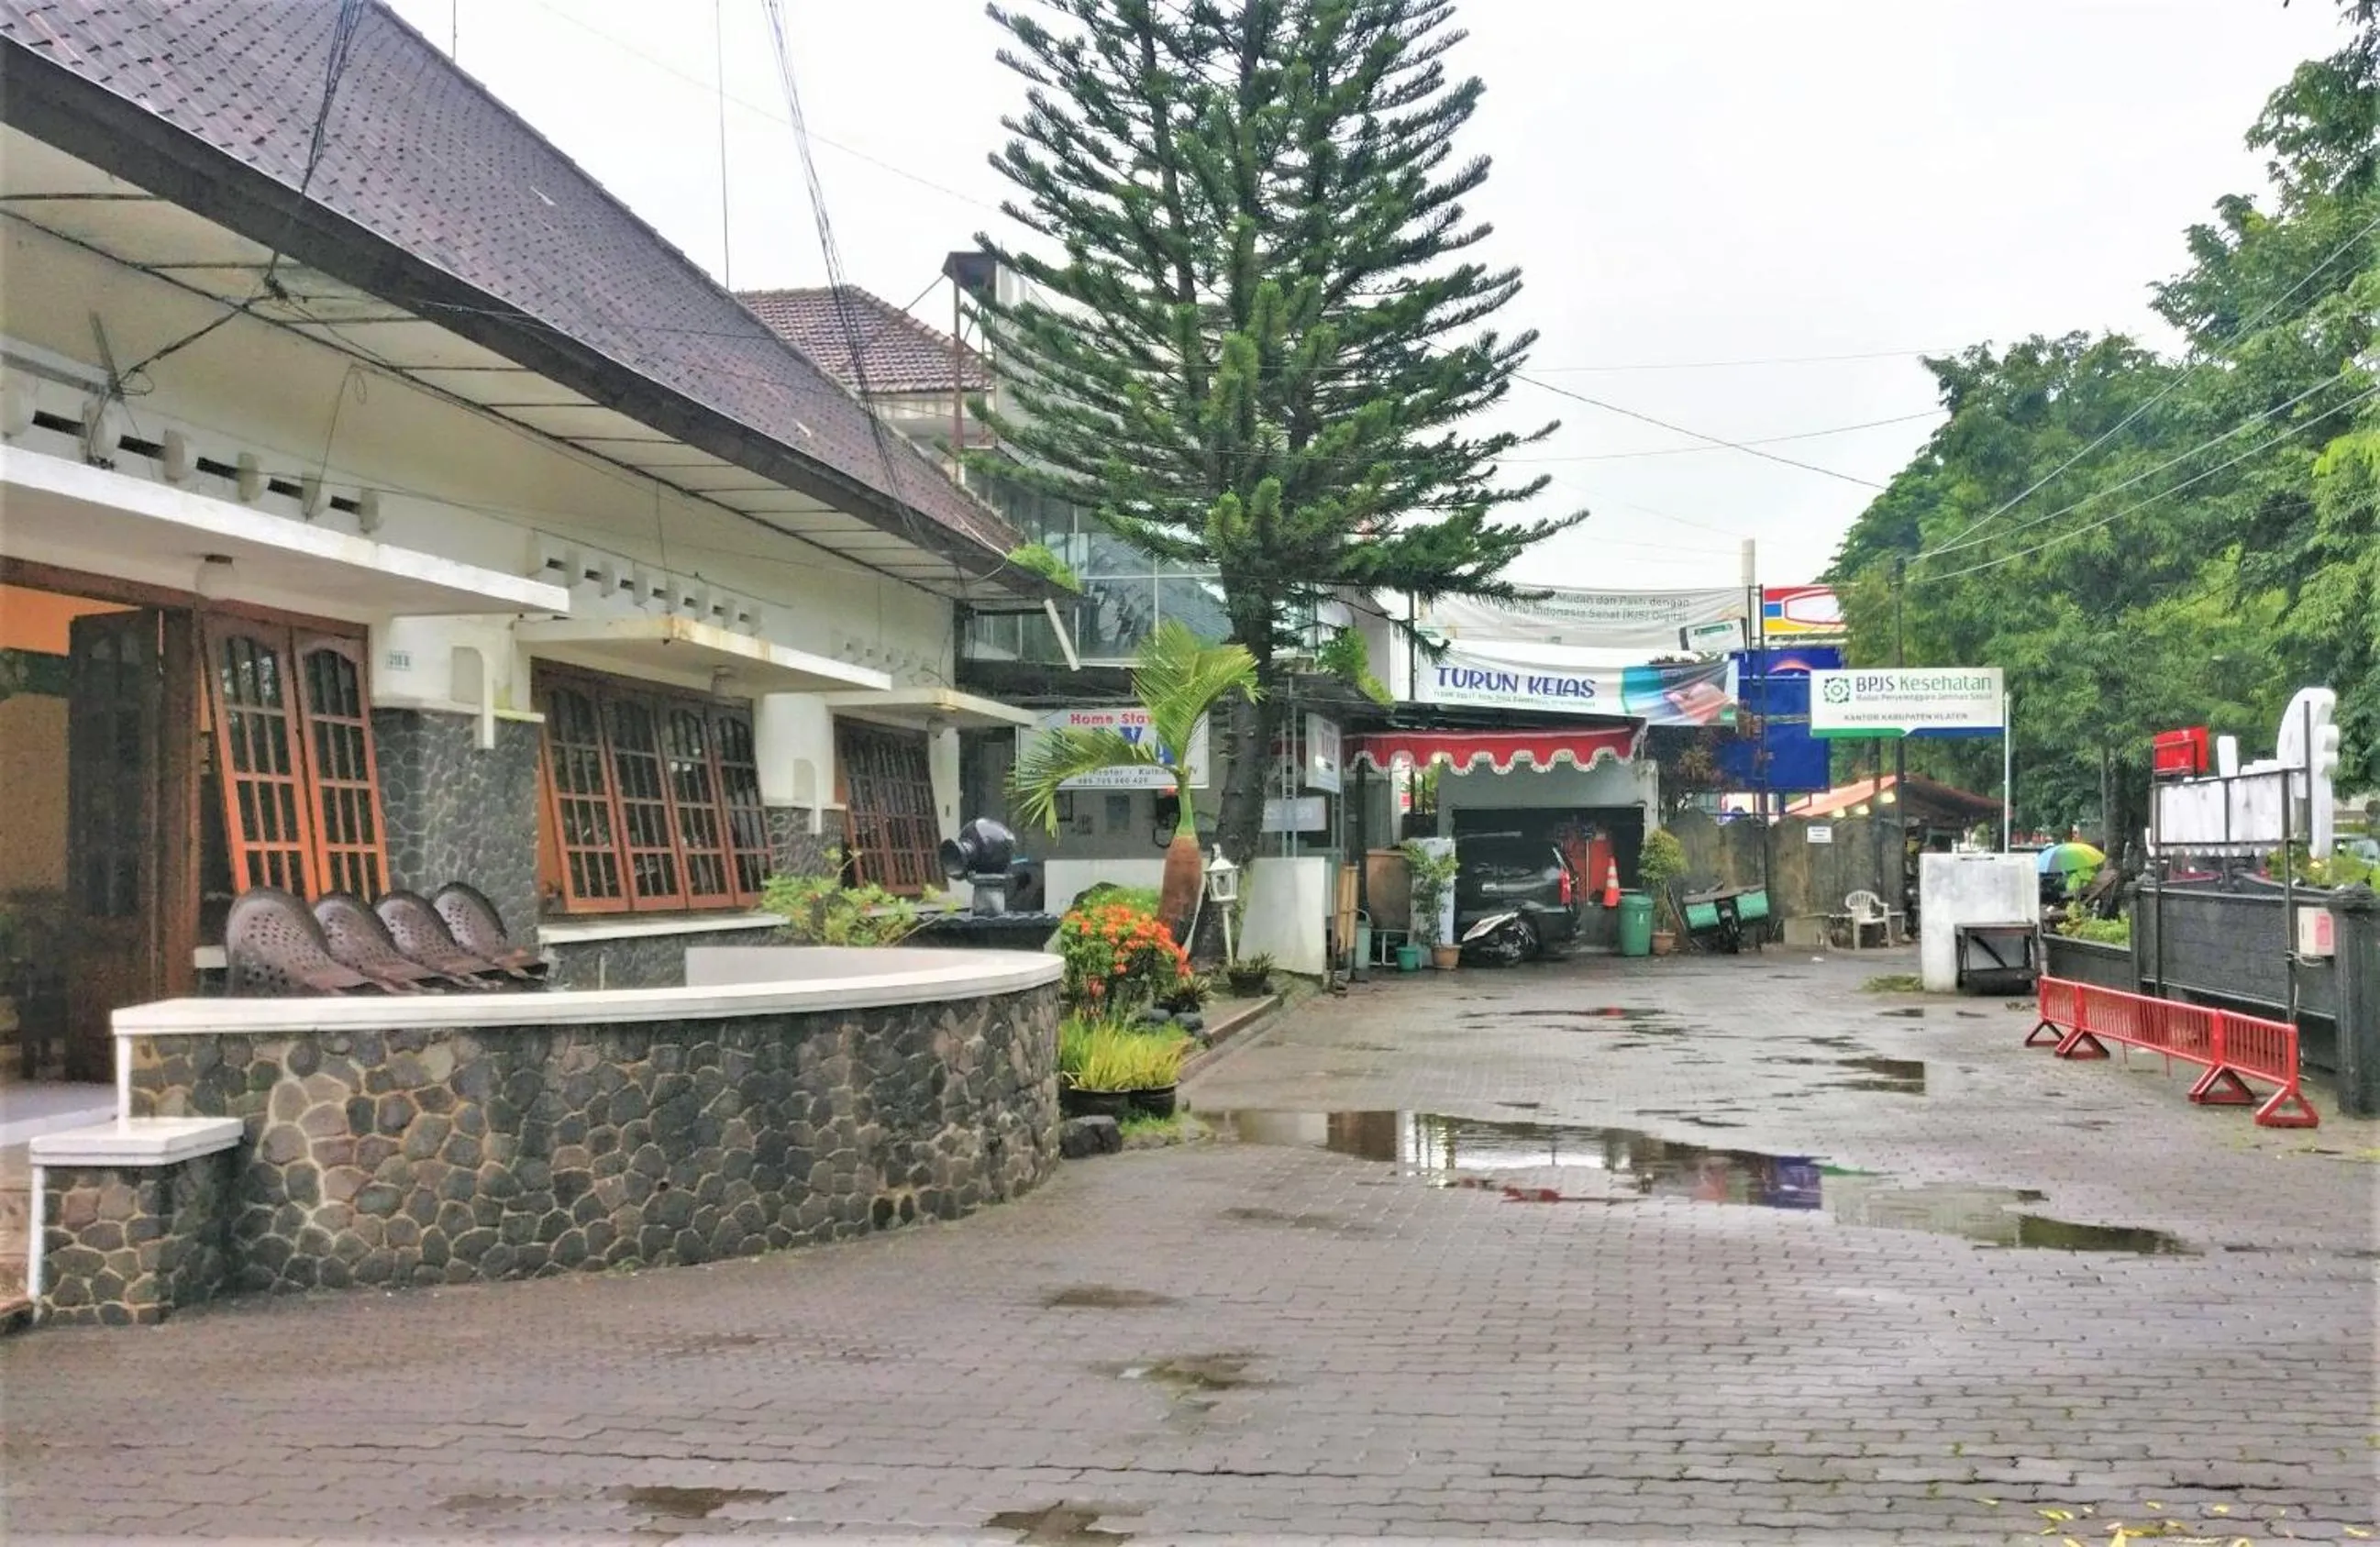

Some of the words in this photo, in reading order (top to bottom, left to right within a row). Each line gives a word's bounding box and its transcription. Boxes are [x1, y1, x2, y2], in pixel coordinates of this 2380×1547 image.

[1555, 593, 1594, 606] Mudah
[1596, 596, 1617, 606] dan
[1648, 596, 1689, 609] dengan
[1534, 605, 1586, 618] Indonesia
[1435, 666, 1520, 692] TURUN
[1528, 676, 1597, 699] KELAS
[1855, 675, 1896, 692] BPJS
[1899, 674, 1992, 692] Kesehatan
[1070, 713, 1113, 725] Home
[1843, 713, 1879, 722] KANTOR
[1934, 713, 1968, 721] KLATEN
